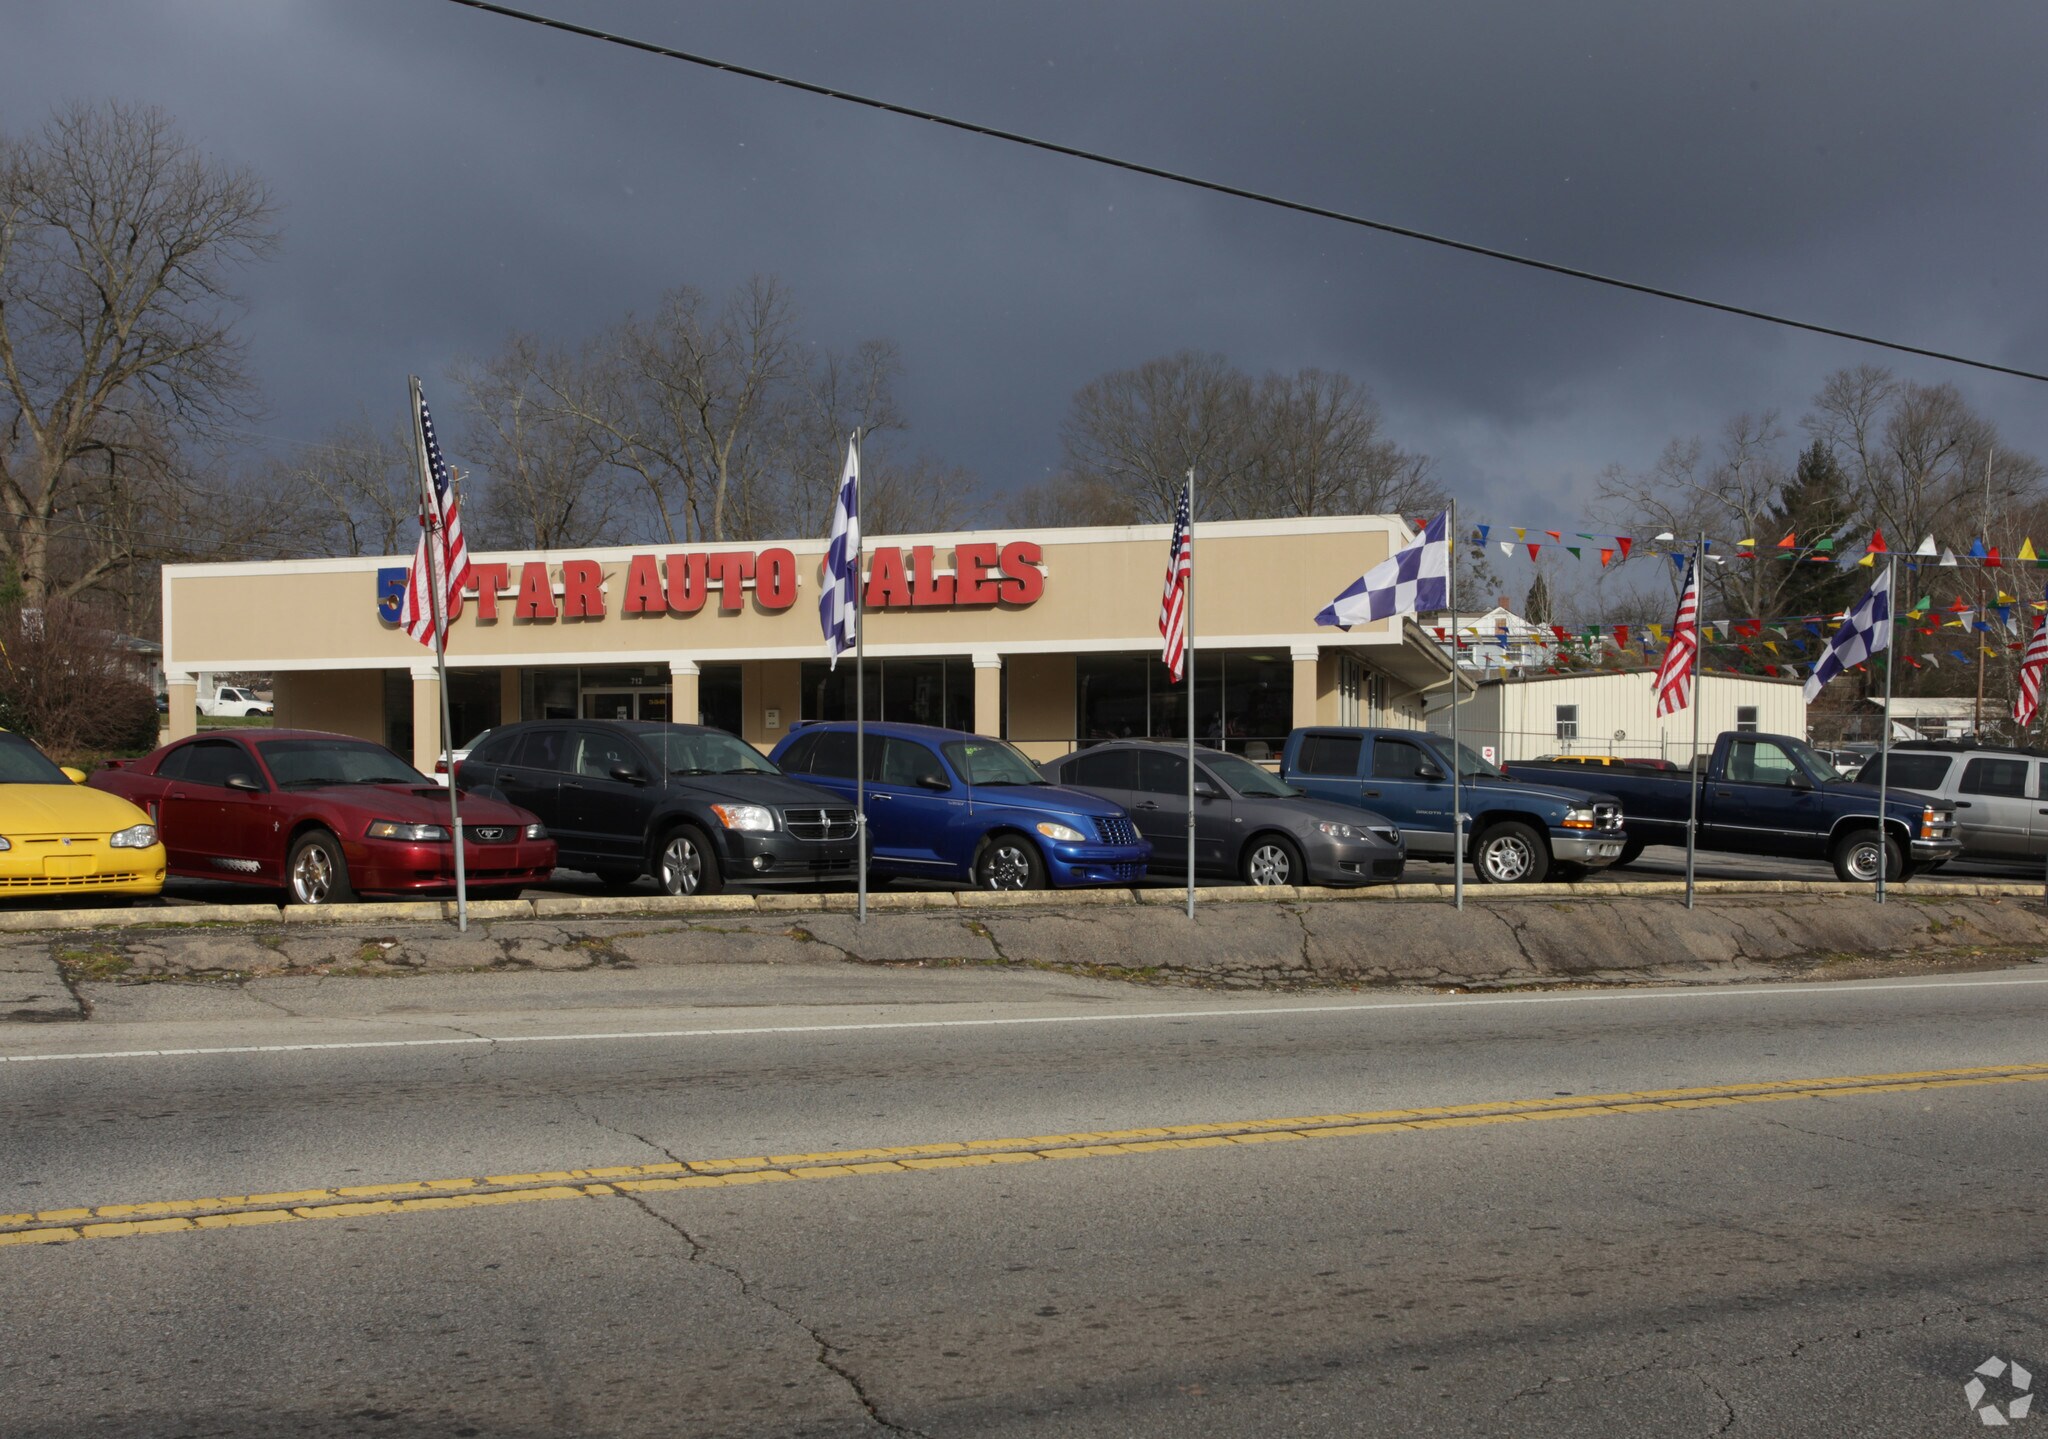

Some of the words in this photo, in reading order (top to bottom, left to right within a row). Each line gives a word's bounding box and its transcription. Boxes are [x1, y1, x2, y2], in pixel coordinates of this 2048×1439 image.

[378, 567, 407, 623] 5
[623, 547, 796, 613] AUTO
[823, 541, 1044, 608] ALES
